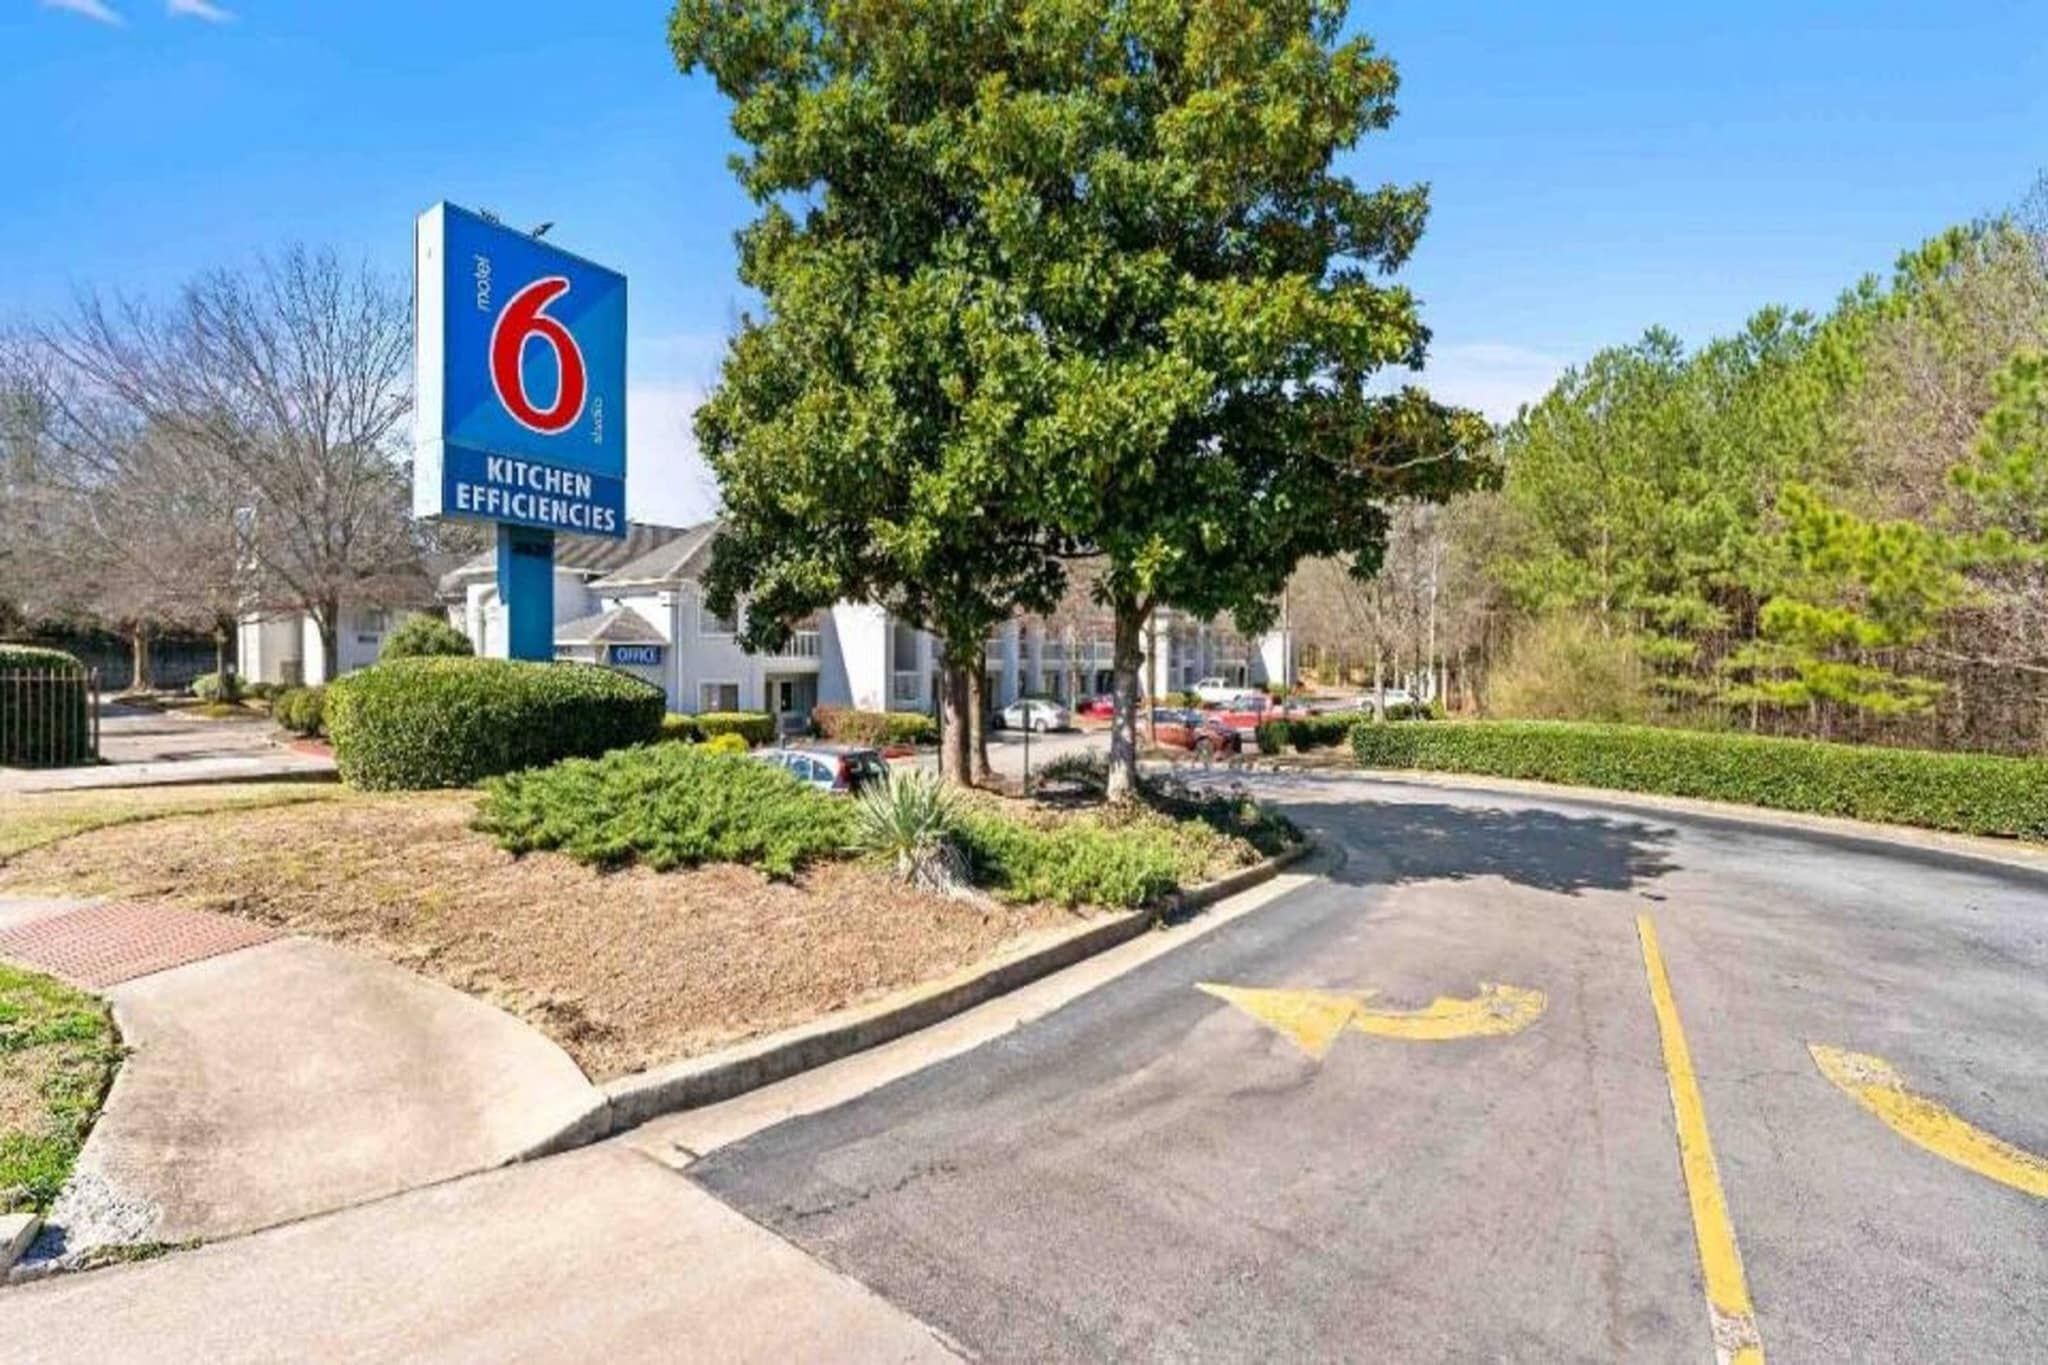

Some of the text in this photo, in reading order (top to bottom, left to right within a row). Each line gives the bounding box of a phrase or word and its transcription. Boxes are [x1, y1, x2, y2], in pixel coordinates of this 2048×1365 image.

[475, 254, 491, 312] motel
[489, 276, 588, 435] 6
[486, 455, 592, 499] KITCHEN
[455, 482, 616, 532] EFFICIENCIES
